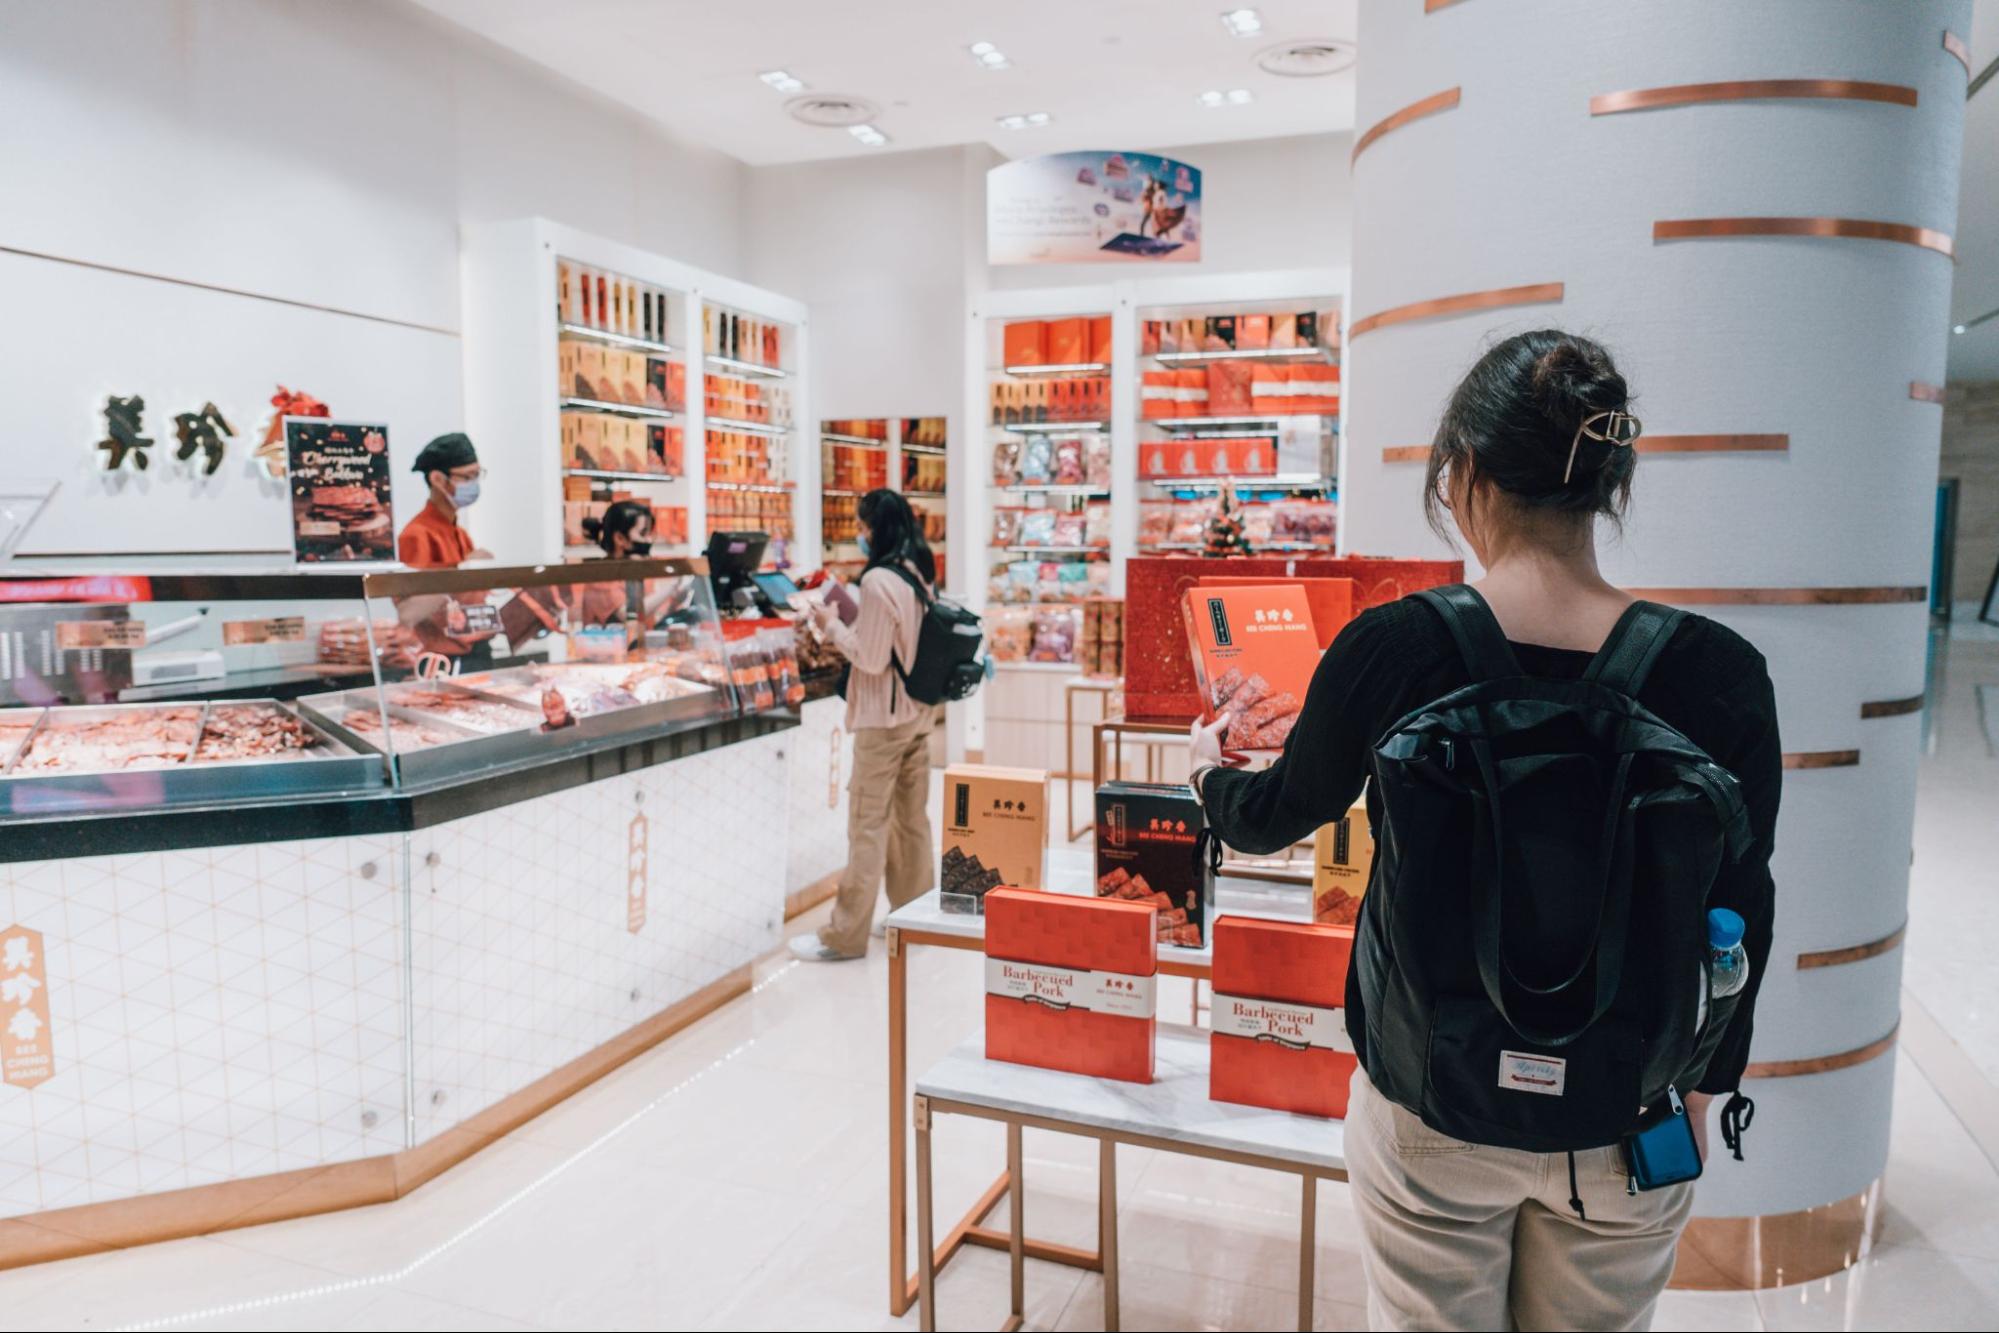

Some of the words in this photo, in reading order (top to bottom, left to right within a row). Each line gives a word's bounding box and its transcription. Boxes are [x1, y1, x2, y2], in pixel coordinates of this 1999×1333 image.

[1003, 965, 1073, 986] Barbecued
[1034, 981, 1064, 997] Pork
[1233, 1003, 1314, 1025] Barbecued
[1268, 1019, 1303, 1036] Pork
